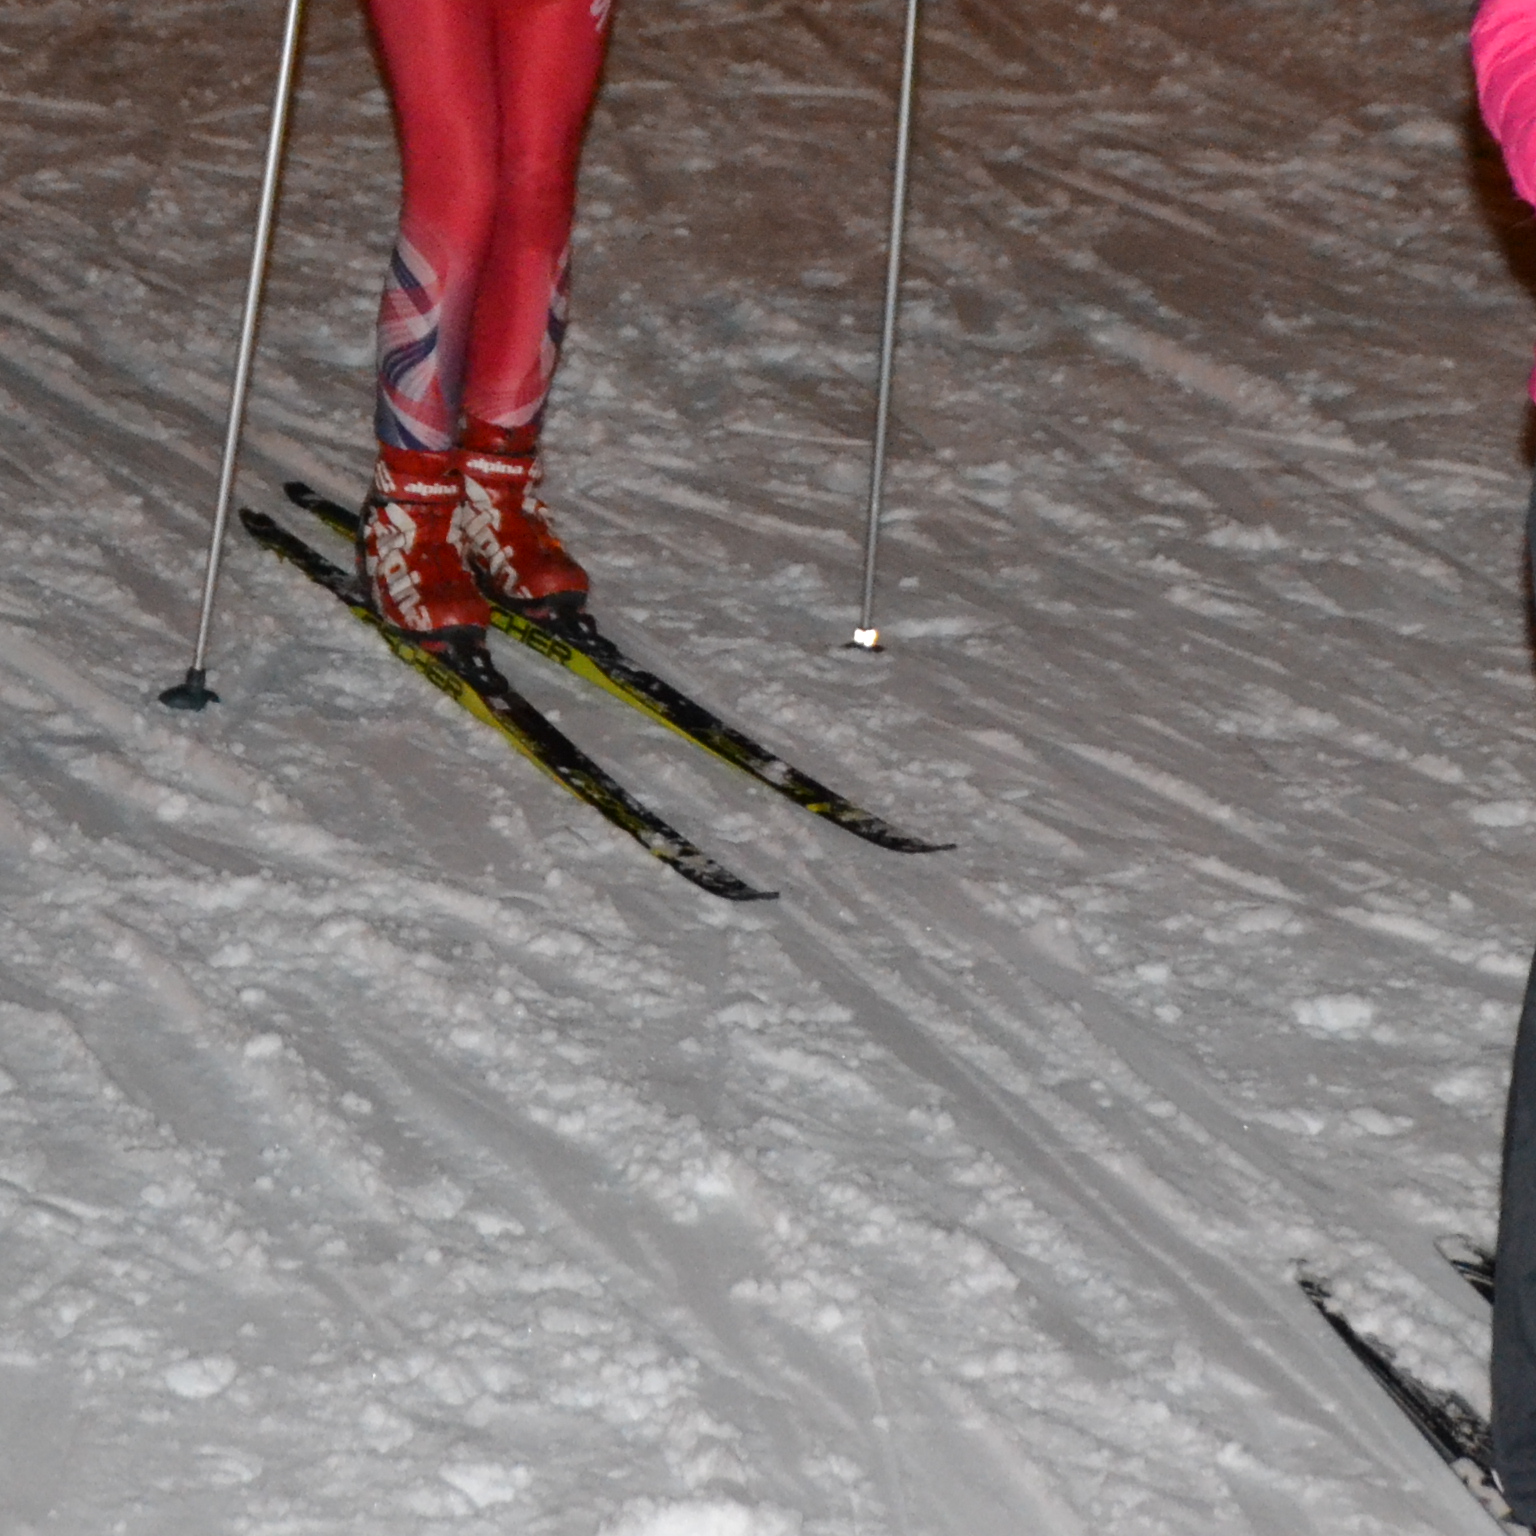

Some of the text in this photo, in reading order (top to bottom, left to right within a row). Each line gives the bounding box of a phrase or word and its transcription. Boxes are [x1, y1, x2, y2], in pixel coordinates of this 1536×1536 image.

[465, 458, 525, 476] alpina
[404, 482, 460, 496] alpina
[490, 606, 572, 663] CHER
